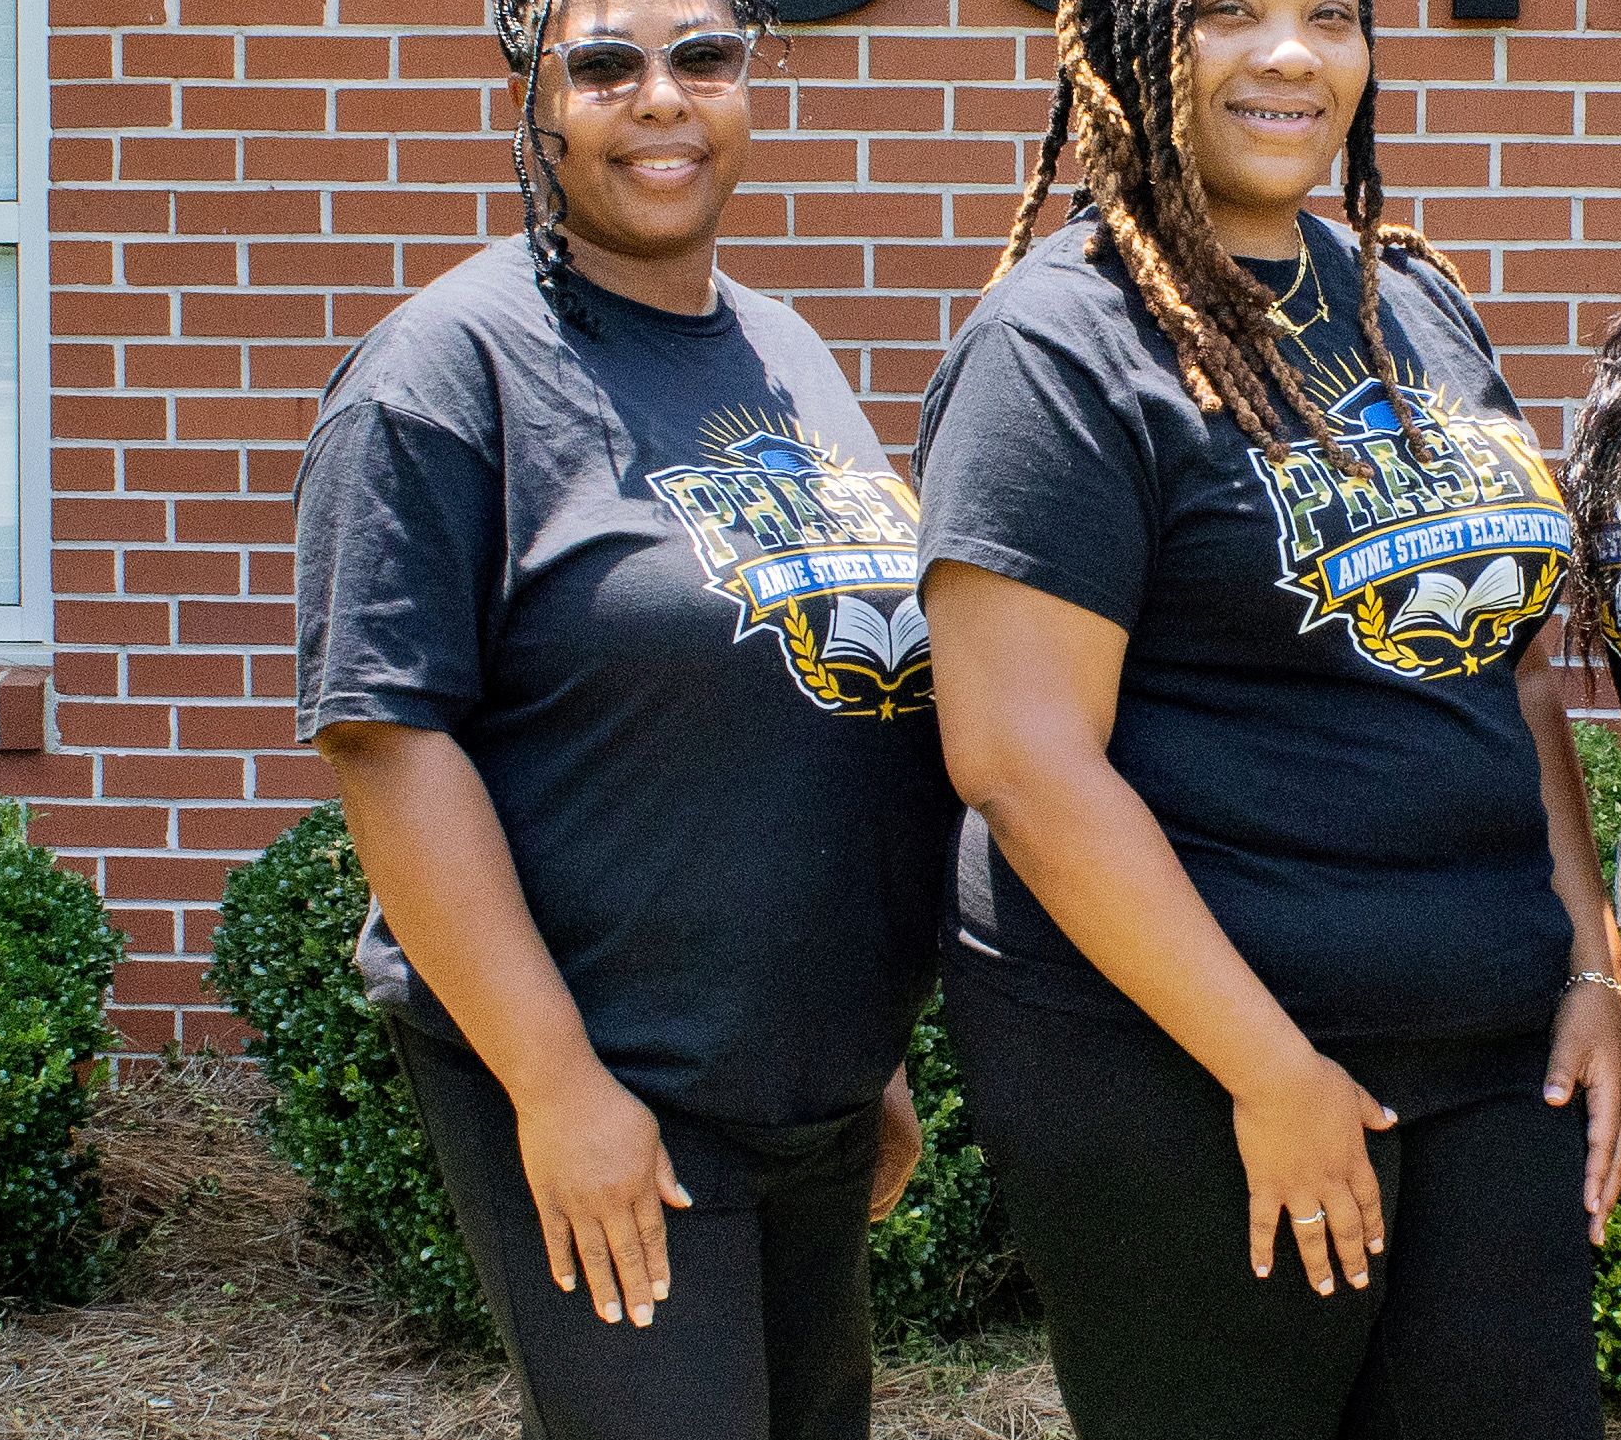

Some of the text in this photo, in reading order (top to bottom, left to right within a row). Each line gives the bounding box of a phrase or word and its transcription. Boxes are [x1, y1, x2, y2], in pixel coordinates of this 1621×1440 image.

[662, 472, 919, 569] PHASE
[1267, 423, 1525, 562] PHASE
[756, 559, 812, 600] ANNE
[807, 553, 878, 584] STREET
[1338, 539, 1393, 590] ANNE
[1395, 520, 1465, 564] STREET
